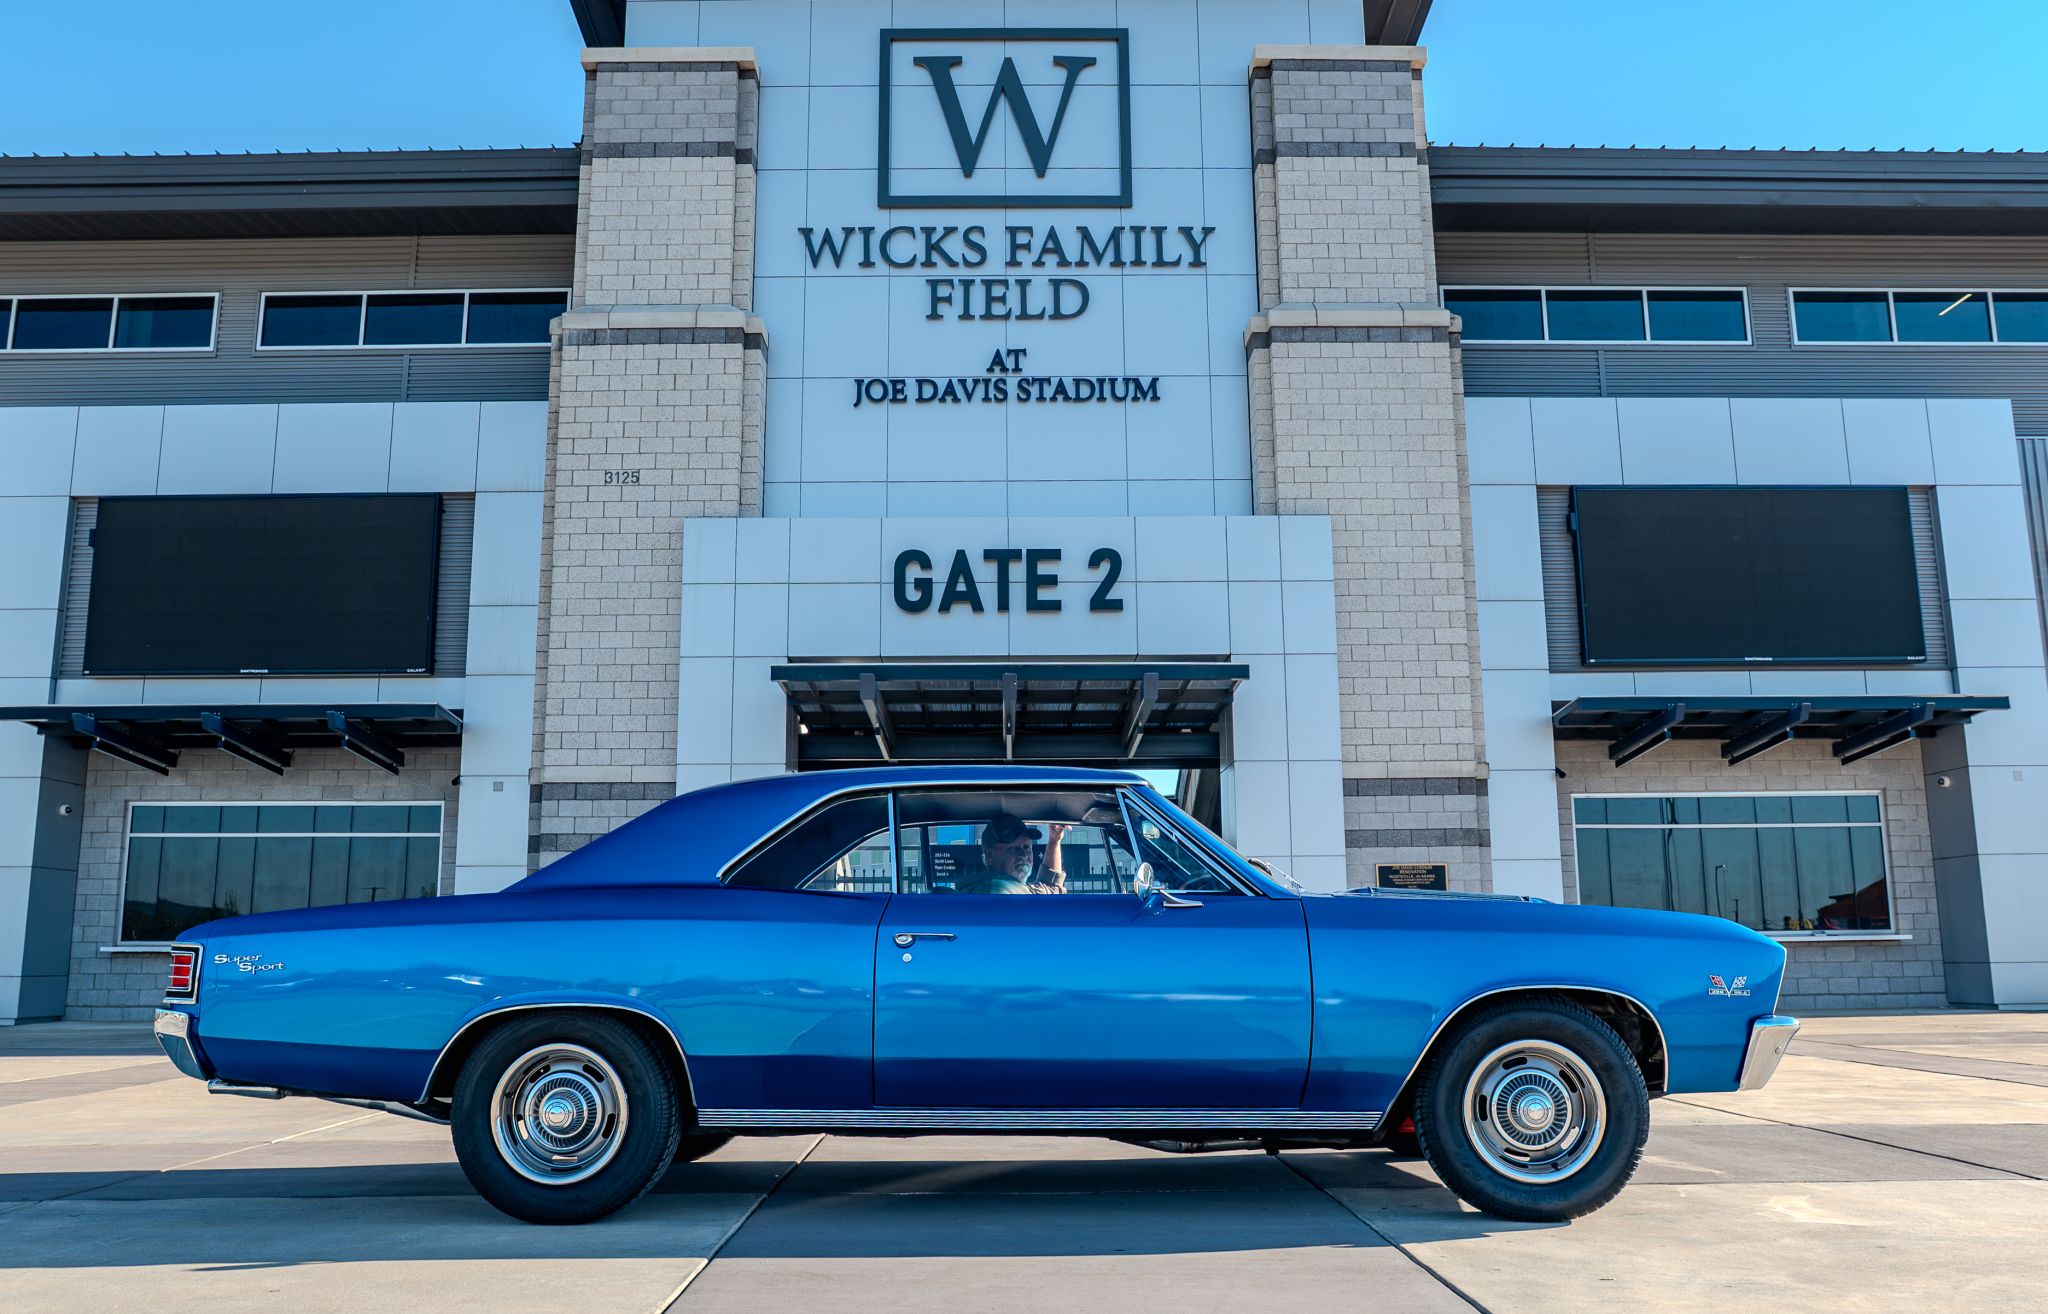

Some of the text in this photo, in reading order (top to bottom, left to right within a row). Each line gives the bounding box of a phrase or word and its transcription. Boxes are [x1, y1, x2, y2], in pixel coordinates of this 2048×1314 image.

[913, 55, 1097, 178] W
[798, 225, 1216, 268] WICKS FAMILY
[926, 278, 1090, 321] FIELD
[987, 348, 1027, 373] AT
[853, 377, 1161, 408] JOE DAVIS STADIUM
[605, 471, 639, 484] 3125
[893, 547, 1124, 614] GATE 2
[214, 954, 263, 966] Super
[239, 962, 285, 975] Sport
